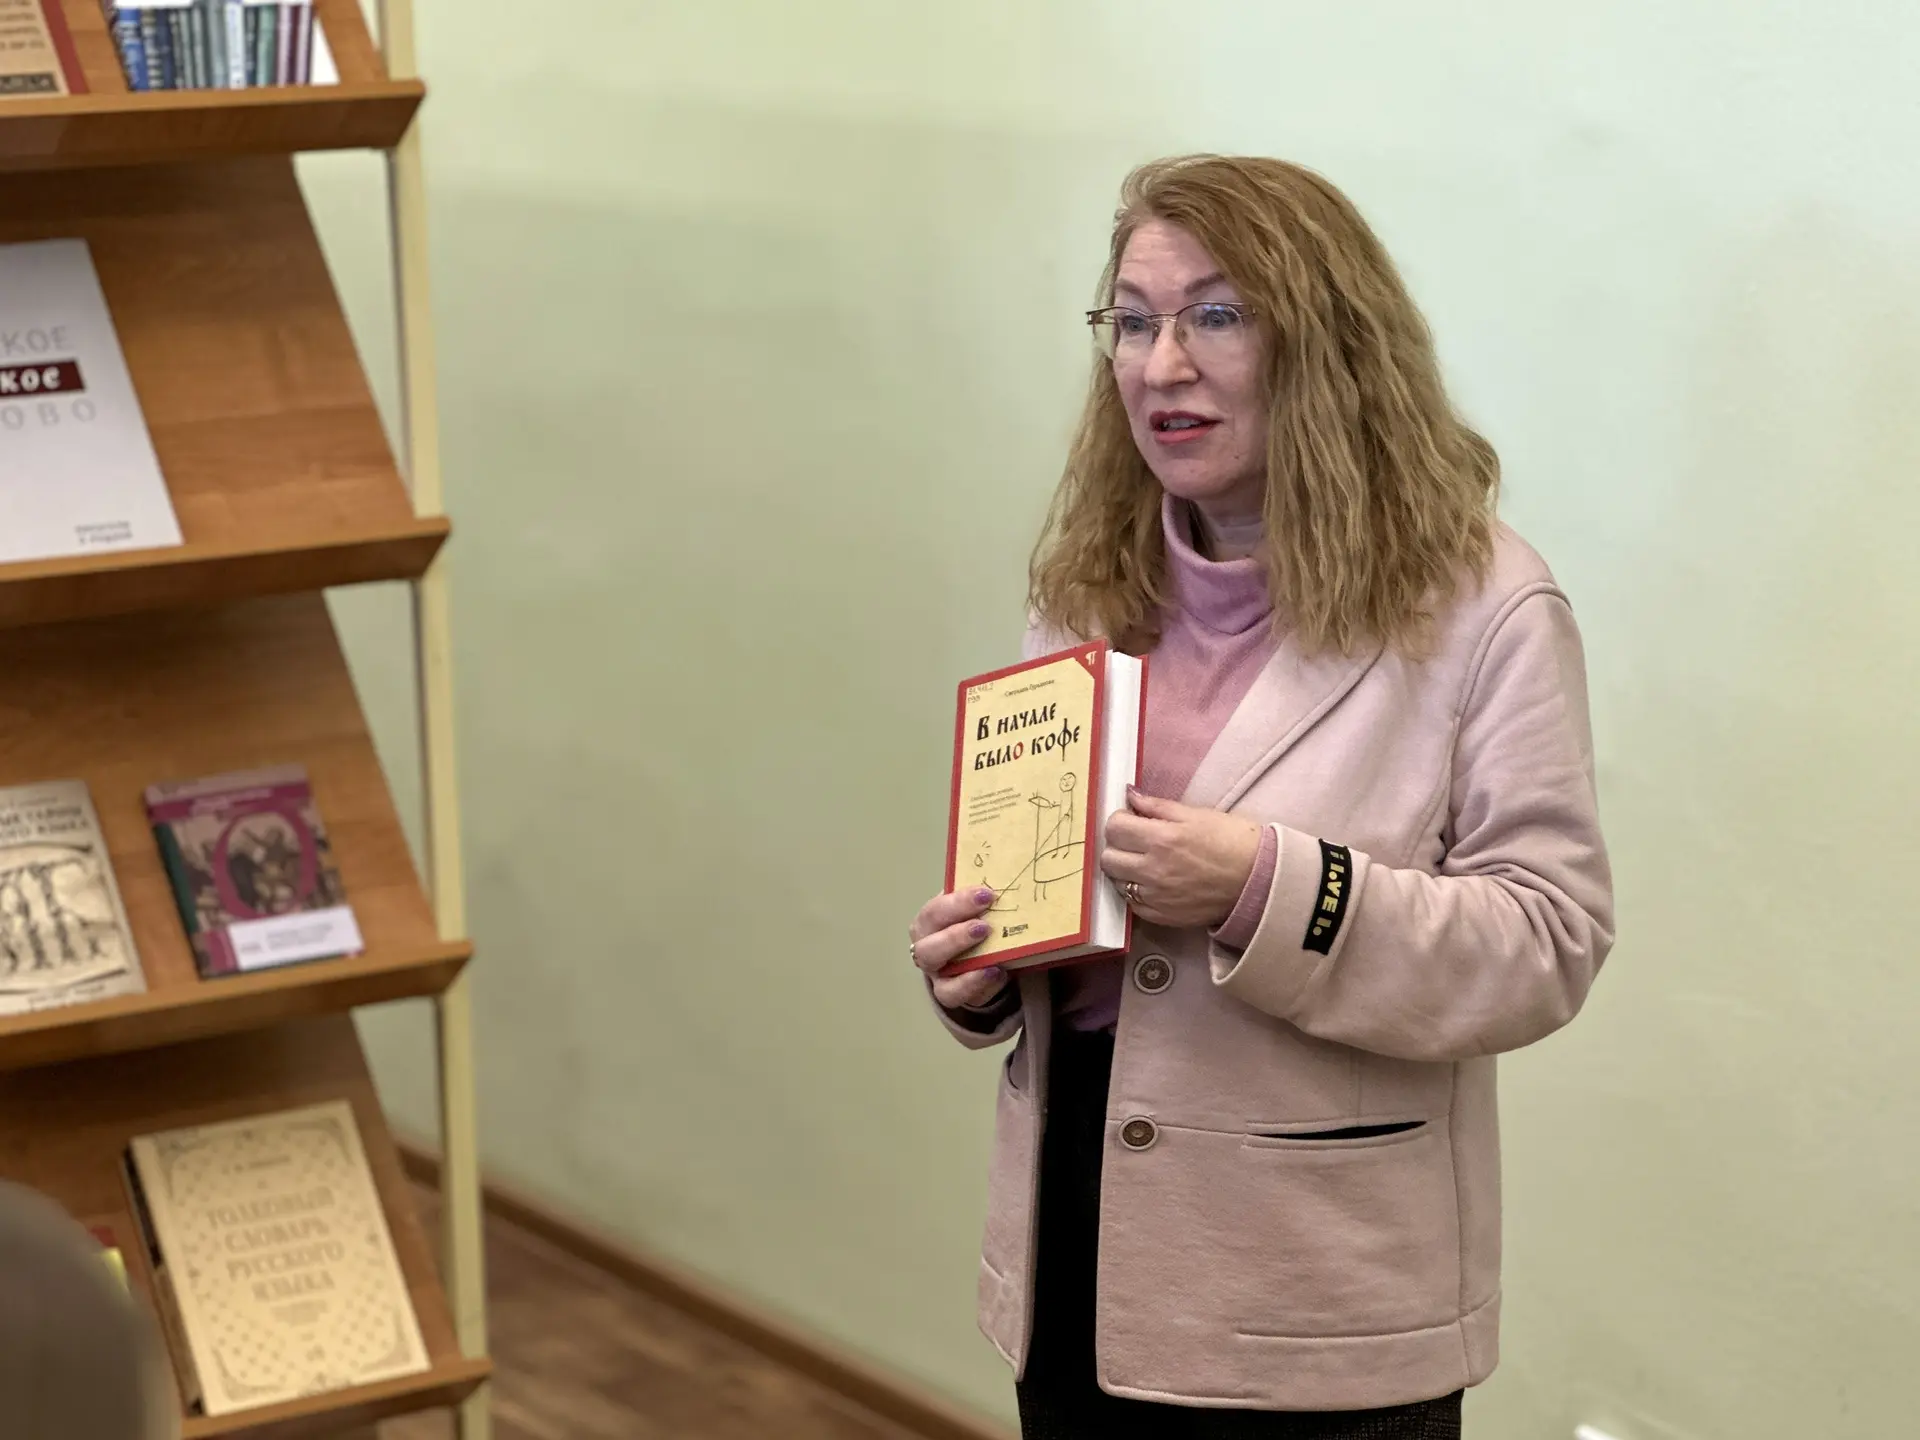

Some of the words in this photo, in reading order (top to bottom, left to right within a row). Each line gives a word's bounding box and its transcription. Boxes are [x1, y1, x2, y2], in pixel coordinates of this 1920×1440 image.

[974, 741, 1025, 771] БЫЛО
[1031, 717, 1081, 762] КОФЕ
[977, 715, 991, 741] В
[997, 702, 1057, 735] НАЧАЛЕ
